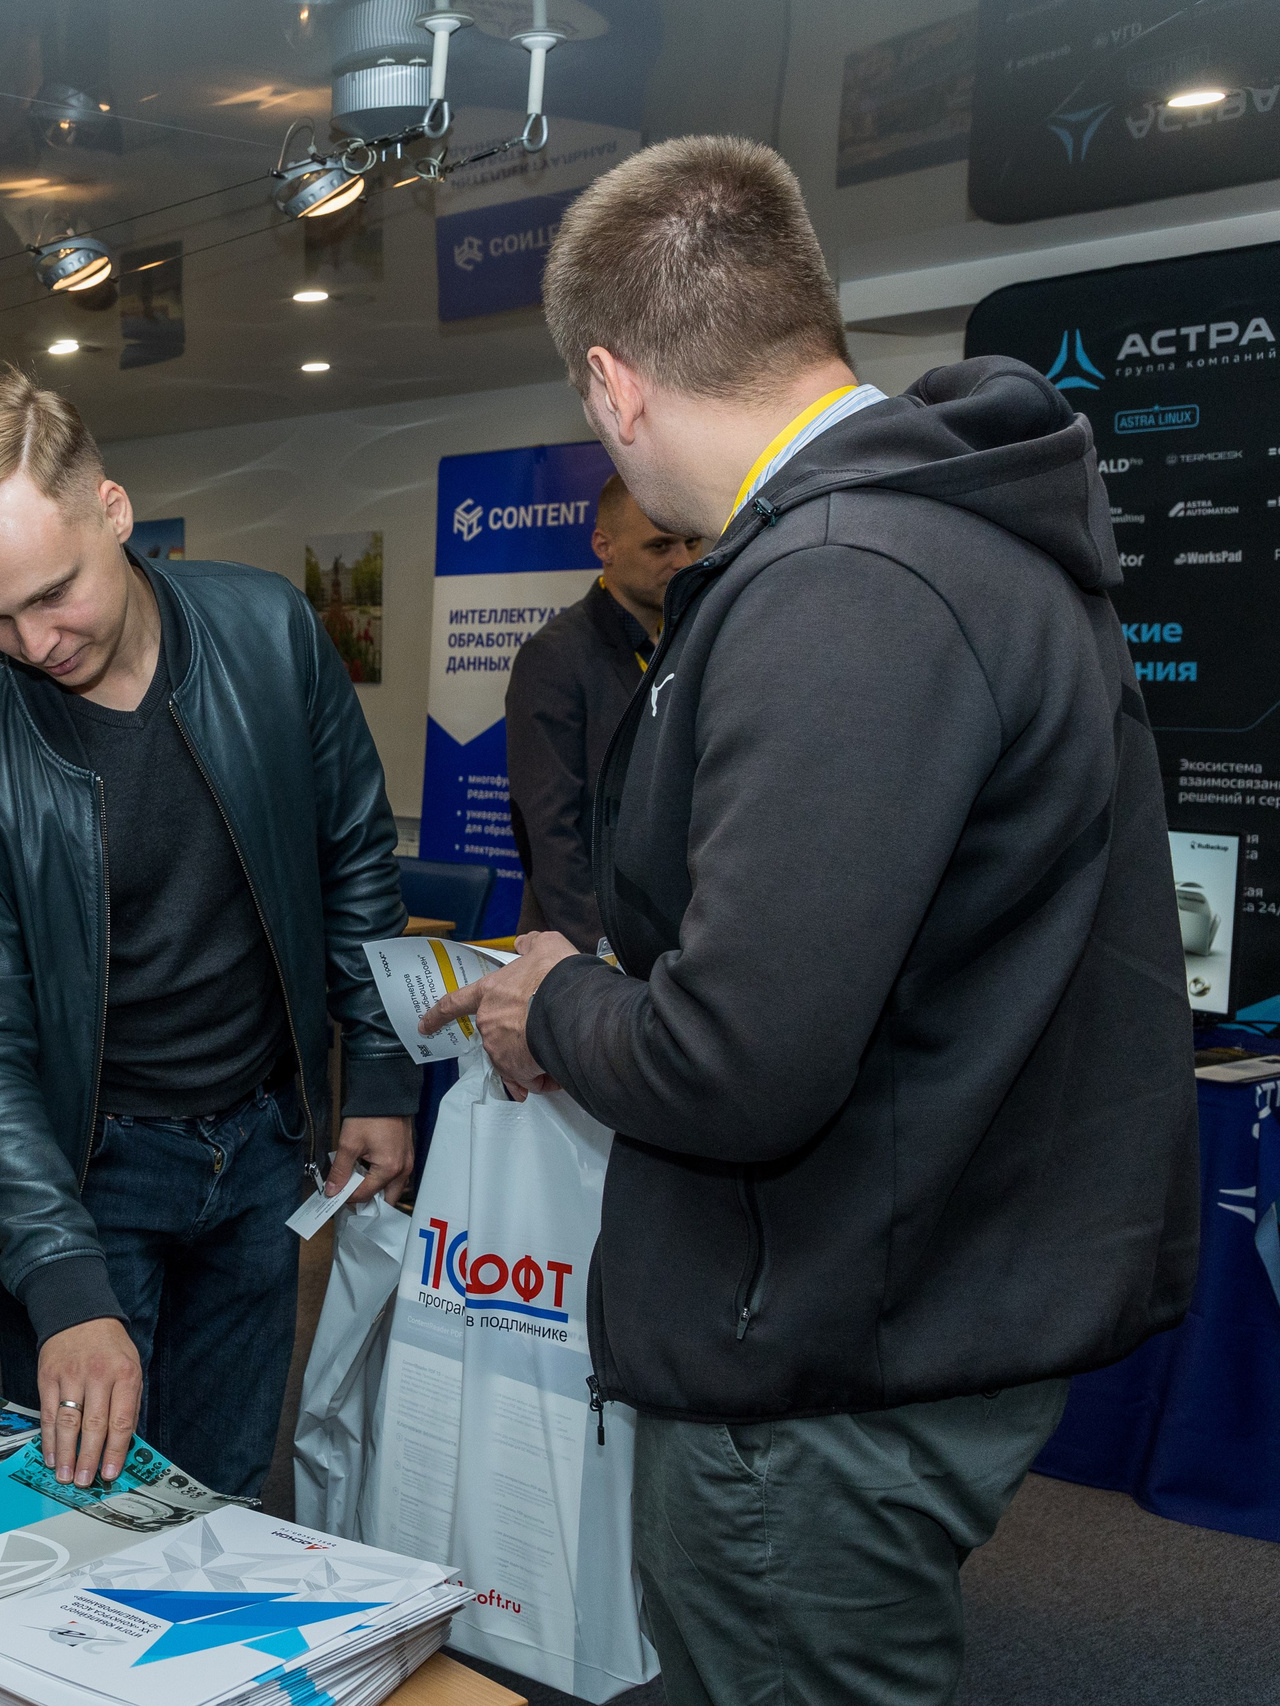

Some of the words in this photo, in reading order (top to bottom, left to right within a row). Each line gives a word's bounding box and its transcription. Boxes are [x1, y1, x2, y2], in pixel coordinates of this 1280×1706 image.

[1116, 317, 1276, 361] АСТРА
[1115, 362, 1175, 377] группа
[1186, 348, 1277, 369] компаний
[1120, 414, 1156, 429] ASTRA
[1158, 411, 1192, 426] LINUX
[1098, 458, 1129, 474] ALD
[488, 501, 590, 531] CONTENT
[1187, 550, 1243, 565] WorksPad
[445, 656, 511, 675] ДАННЫХ
[1179, 758, 1263, 774] Экосистема
[468, 774, 509, 788] многофу
[1179, 776, 1280, 790] взаимосвязан
[1178, 791, 1243, 804] решений
[1245, 795, 1256, 805] и
[1258, 795, 1280, 810] сер
[466, 810, 512, 822] универса
[403, 973, 422, 1014] партнеров
[480, 1316, 568, 1343] подлиннике
